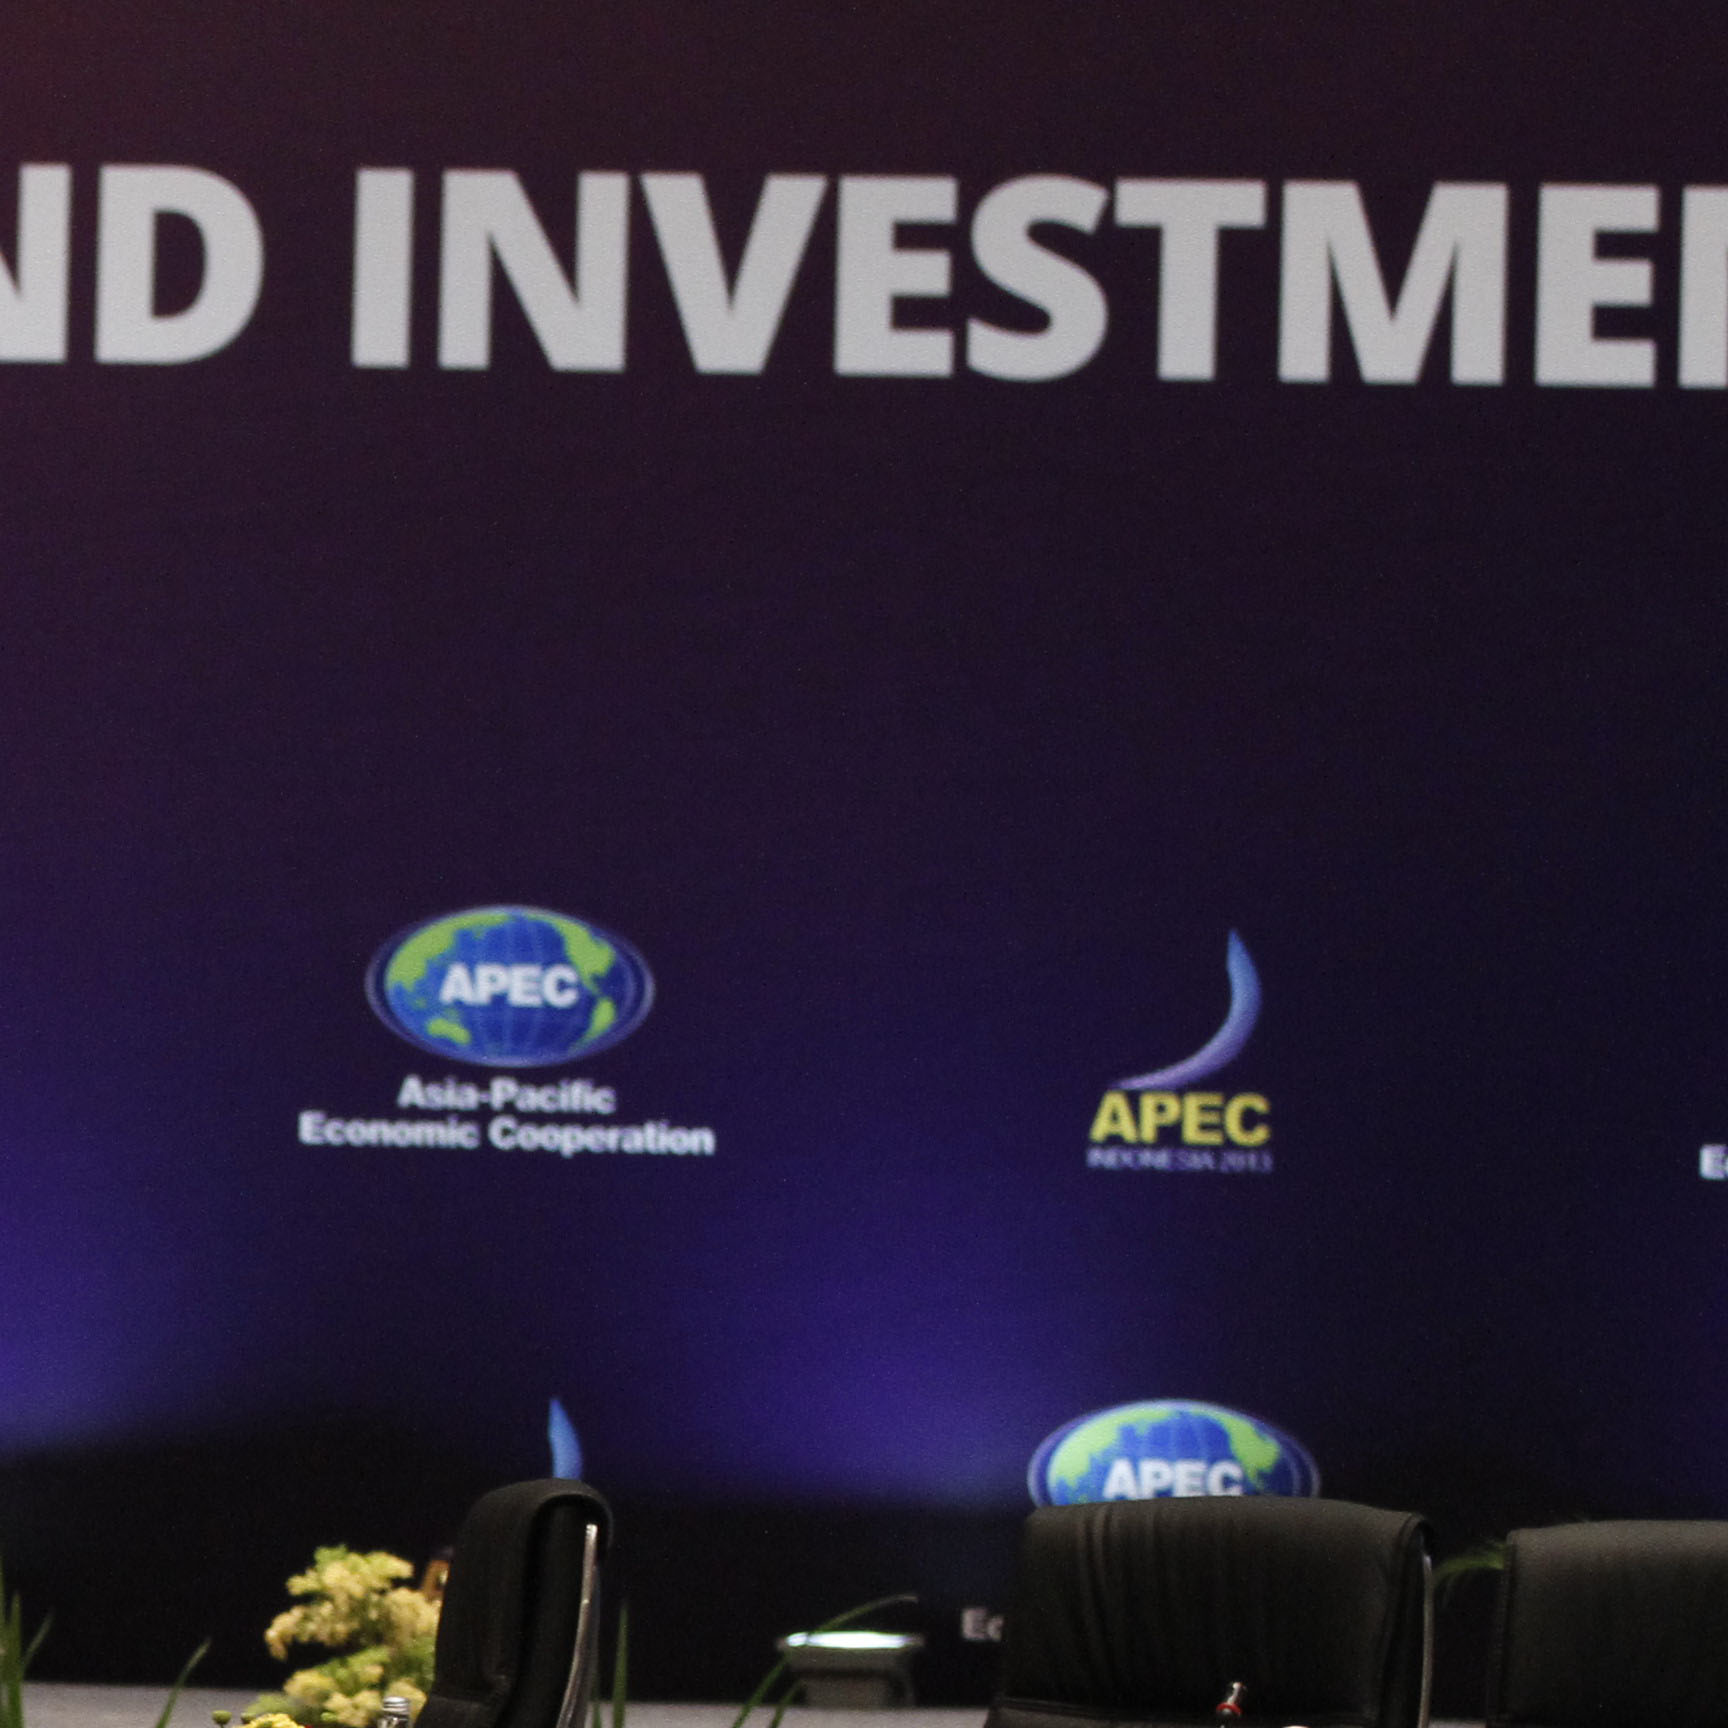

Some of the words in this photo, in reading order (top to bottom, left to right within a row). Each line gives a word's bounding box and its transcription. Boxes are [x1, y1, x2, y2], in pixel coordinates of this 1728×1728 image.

[438, 962, 581, 1009] APEC
[397, 1075, 616, 1115] Asia-Pacific
[1089, 1090, 1271, 1147] APEC
[297, 1111, 480, 1149] Economic
[487, 1115, 716, 1159] Cooperation
[1101, 1456, 1245, 1499] APEC
